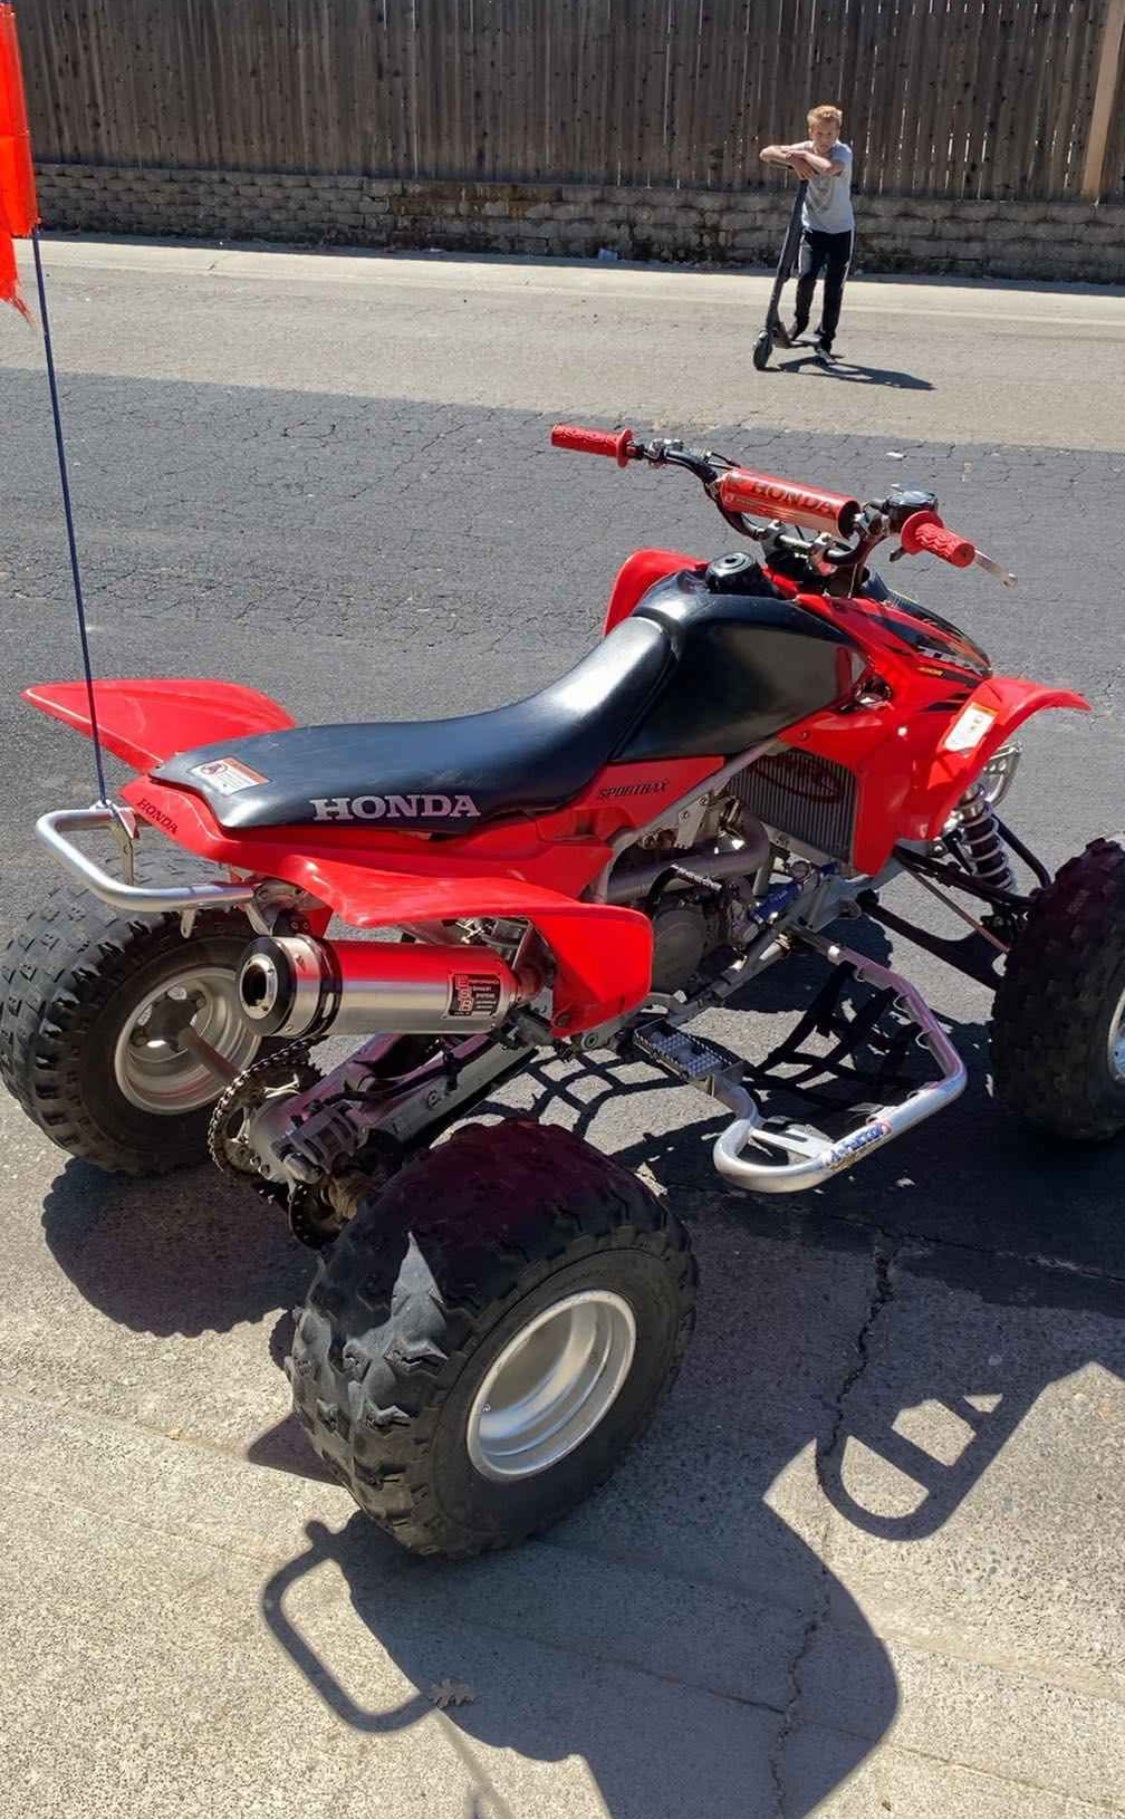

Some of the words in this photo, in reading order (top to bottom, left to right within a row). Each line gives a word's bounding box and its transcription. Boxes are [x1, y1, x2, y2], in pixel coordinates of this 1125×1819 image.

[751, 480, 837, 518] HONDA
[136, 798, 179, 835] HONDA
[309, 795, 482, 821] HONDA
